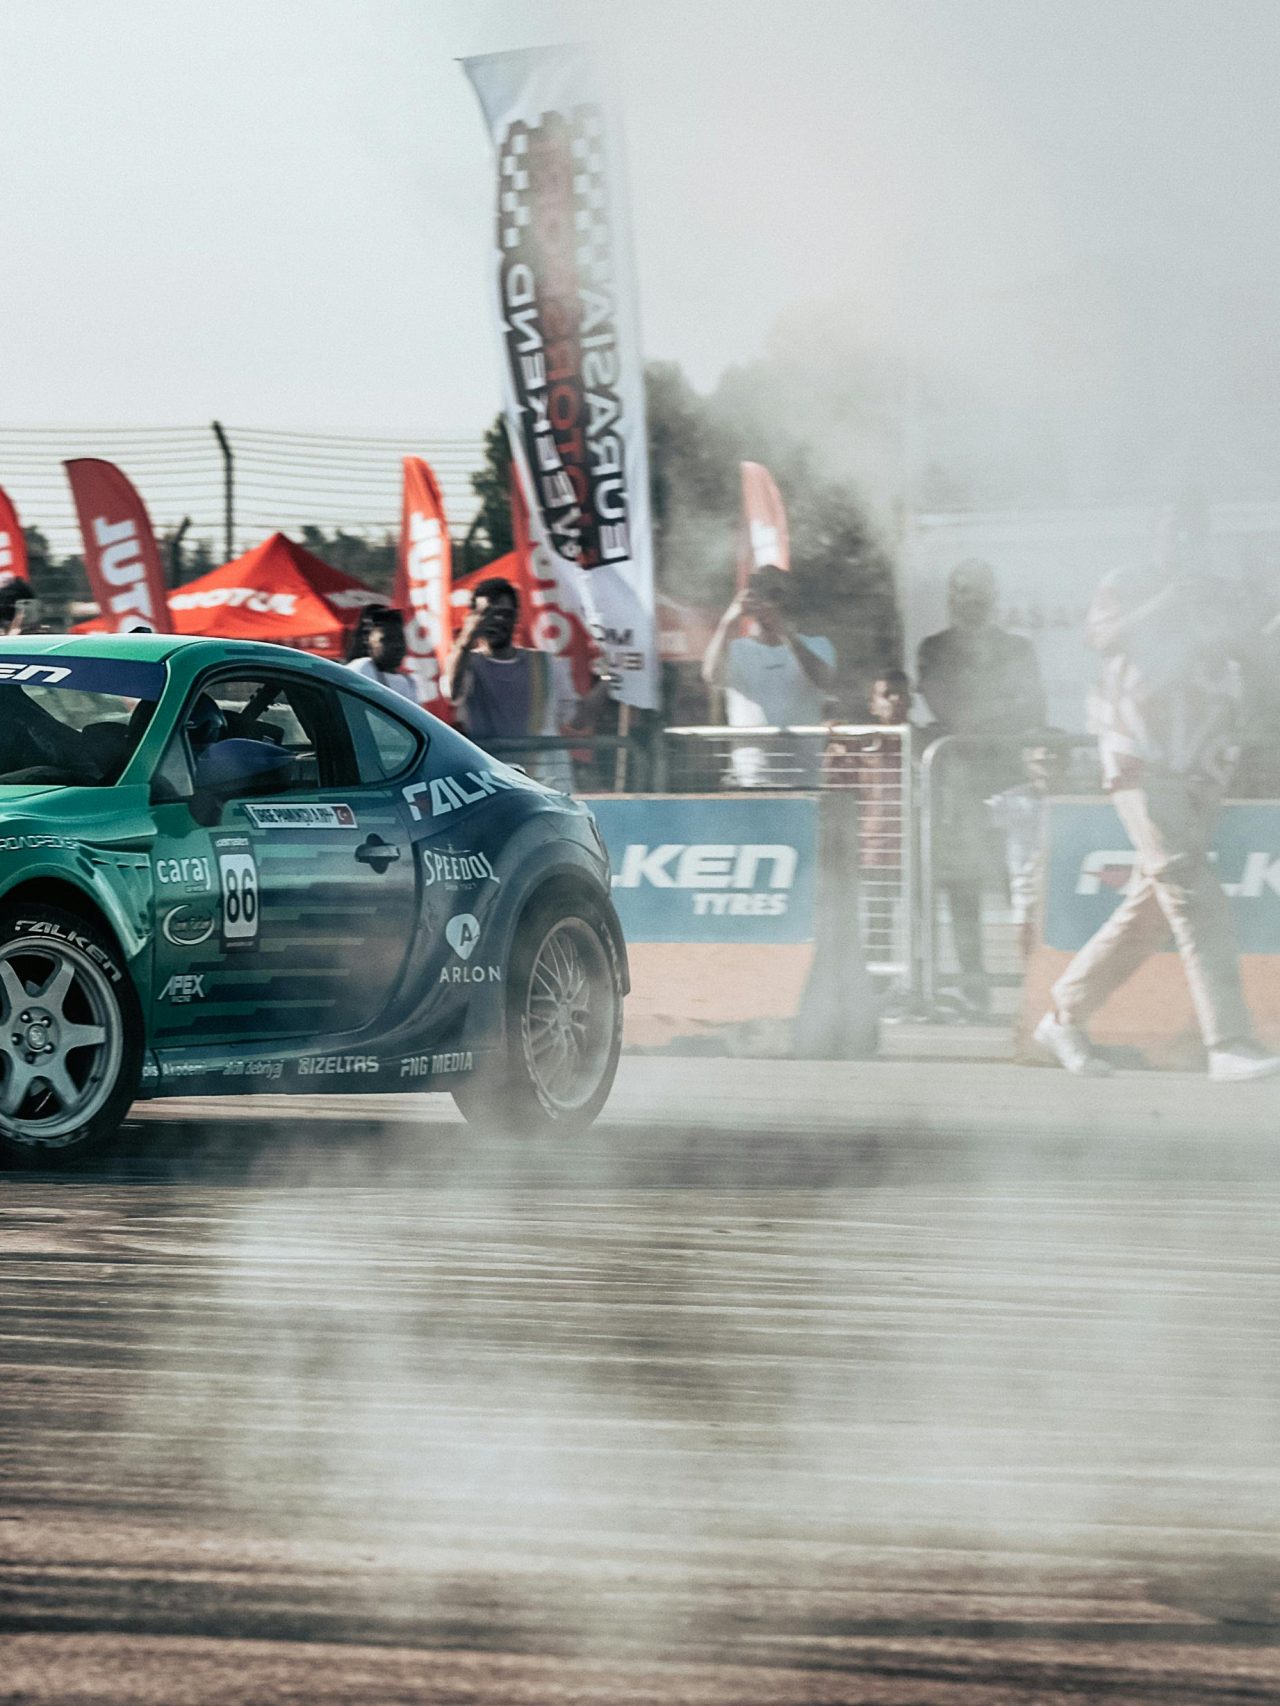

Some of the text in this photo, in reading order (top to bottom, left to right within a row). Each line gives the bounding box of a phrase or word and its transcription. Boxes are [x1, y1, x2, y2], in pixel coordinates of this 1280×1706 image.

[401, 770, 513, 822] FALK
[156, 857, 211, 891] caraj
[423, 849, 501, 887] SPEEDOL
[611, 843, 799, 889] KEN
[225, 868, 257, 924] 86
[691, 892, 789, 917] TYRES
[14, 919, 123, 983] FALKEN
[157, 973, 206, 1000] APEX
[439, 965, 502, 984] ARLON
